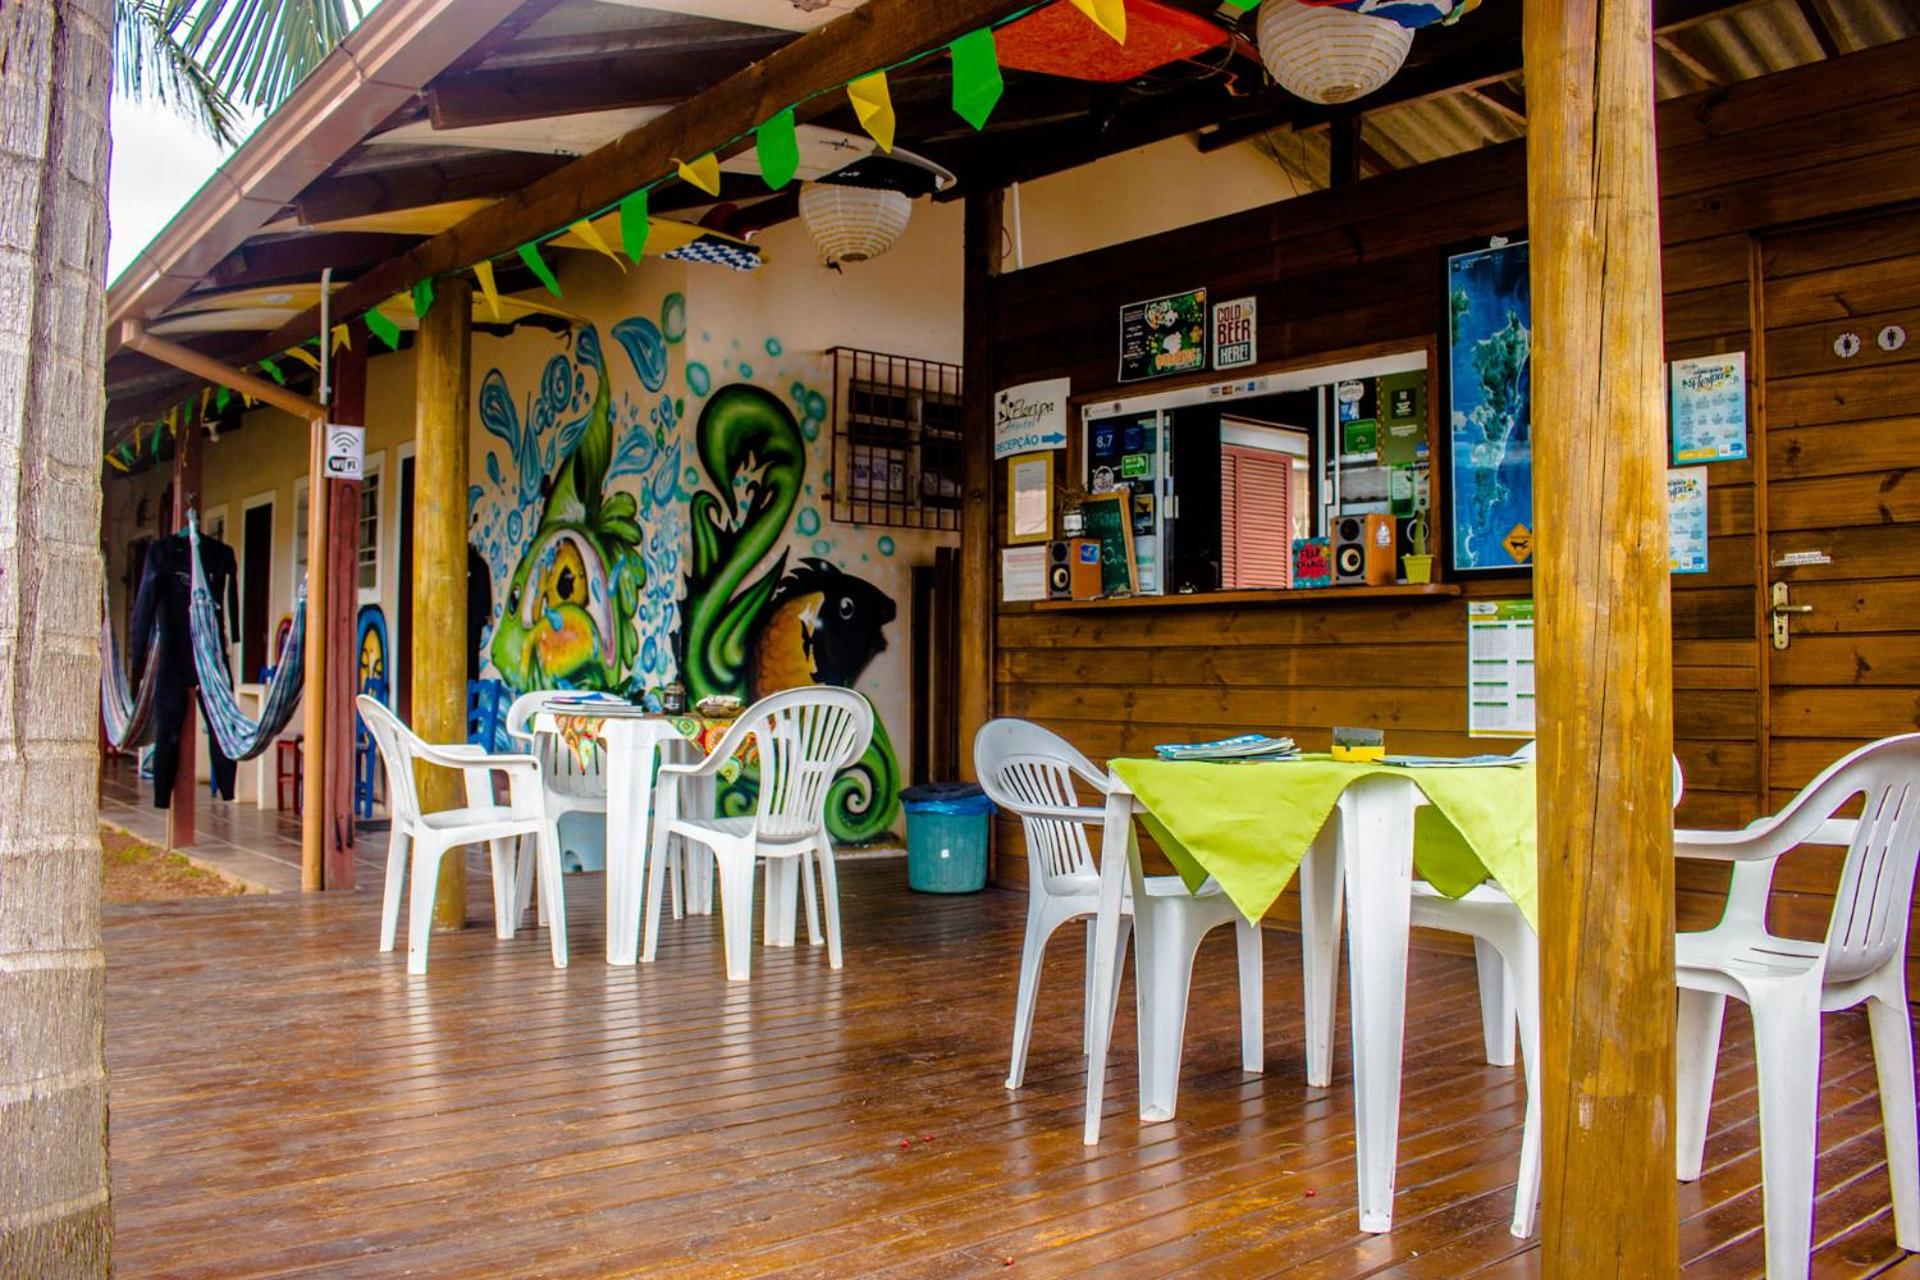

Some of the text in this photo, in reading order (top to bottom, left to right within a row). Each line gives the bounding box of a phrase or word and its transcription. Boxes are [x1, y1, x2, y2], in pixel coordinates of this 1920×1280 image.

[1217, 304, 1241, 323] COLD
[1217, 319, 1251, 346] BEER
[1220, 344, 1248, 364] HERE!
